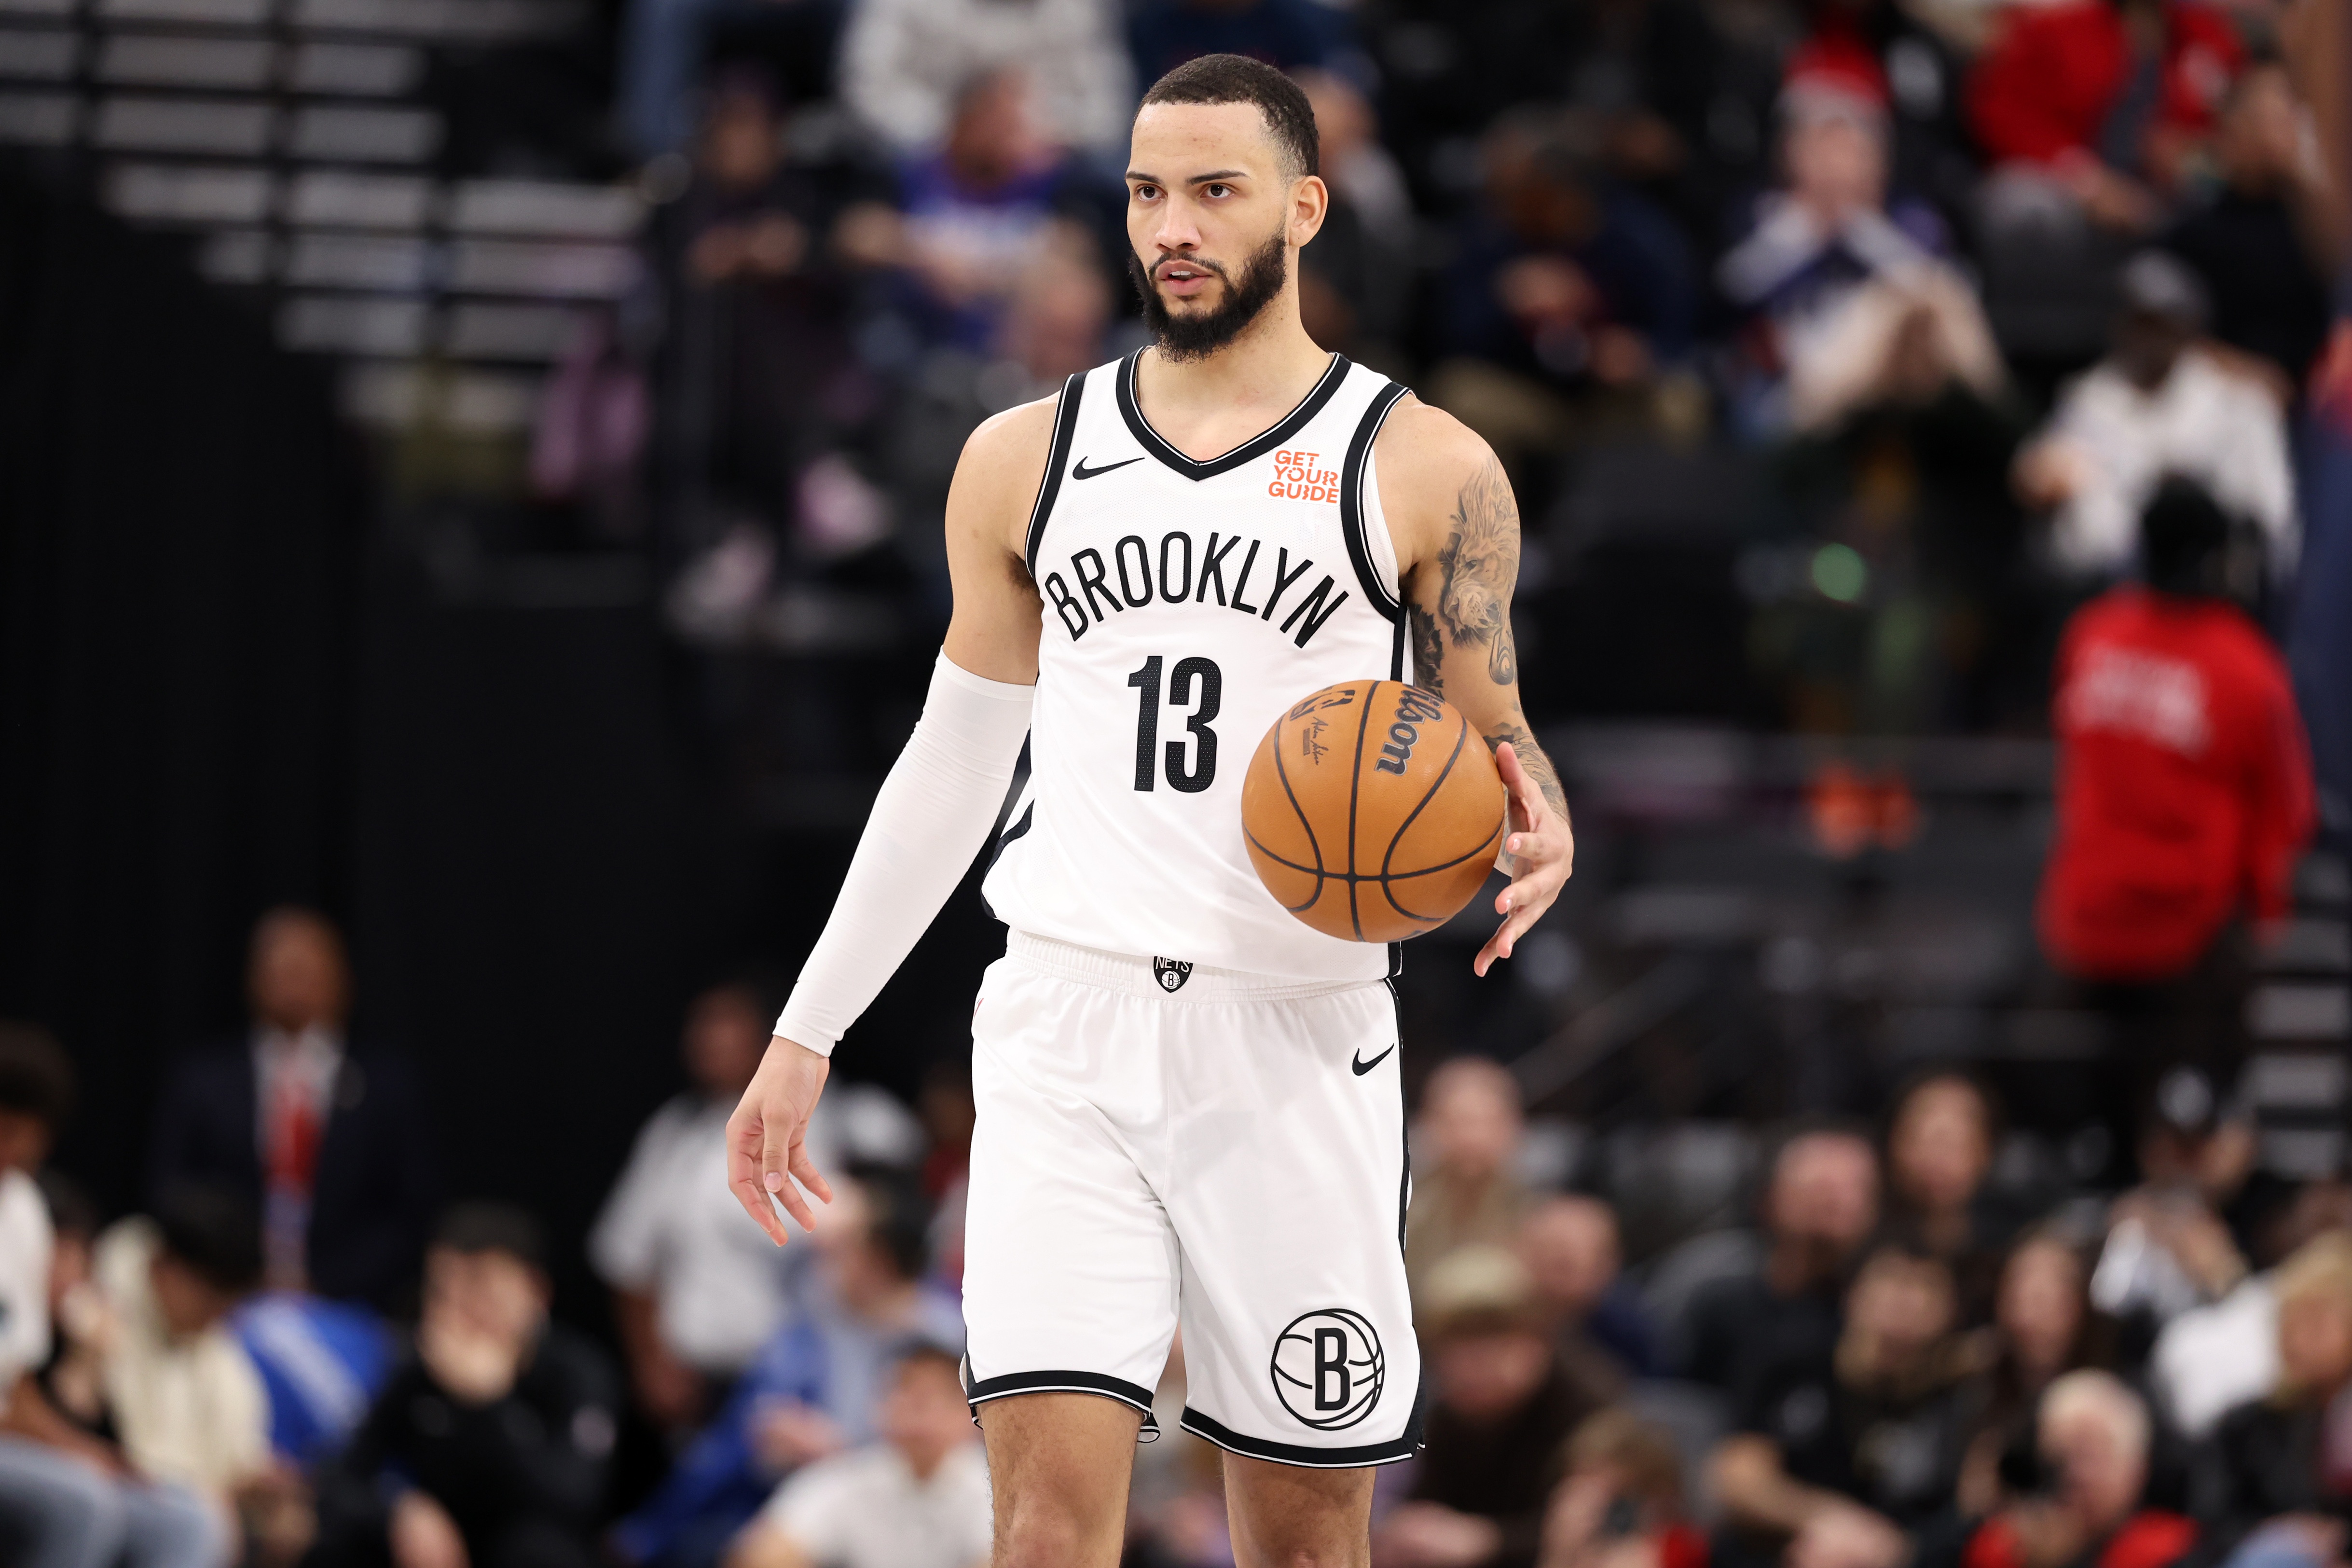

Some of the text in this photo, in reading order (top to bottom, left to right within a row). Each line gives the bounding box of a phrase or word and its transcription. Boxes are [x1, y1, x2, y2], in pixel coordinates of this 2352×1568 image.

[1274, 465, 1338, 487] YOUR
[1275, 450, 1320, 467] GET
[1268, 481, 1339, 503] GUIDE
[1045, 532, 1349, 648] BROOKLYN
[1128, 656, 1222, 793] 13
[1374, 683, 1444, 776] ilson
[1168, 973, 1174, 986] B
[1315, 1328, 1350, 1411] B
